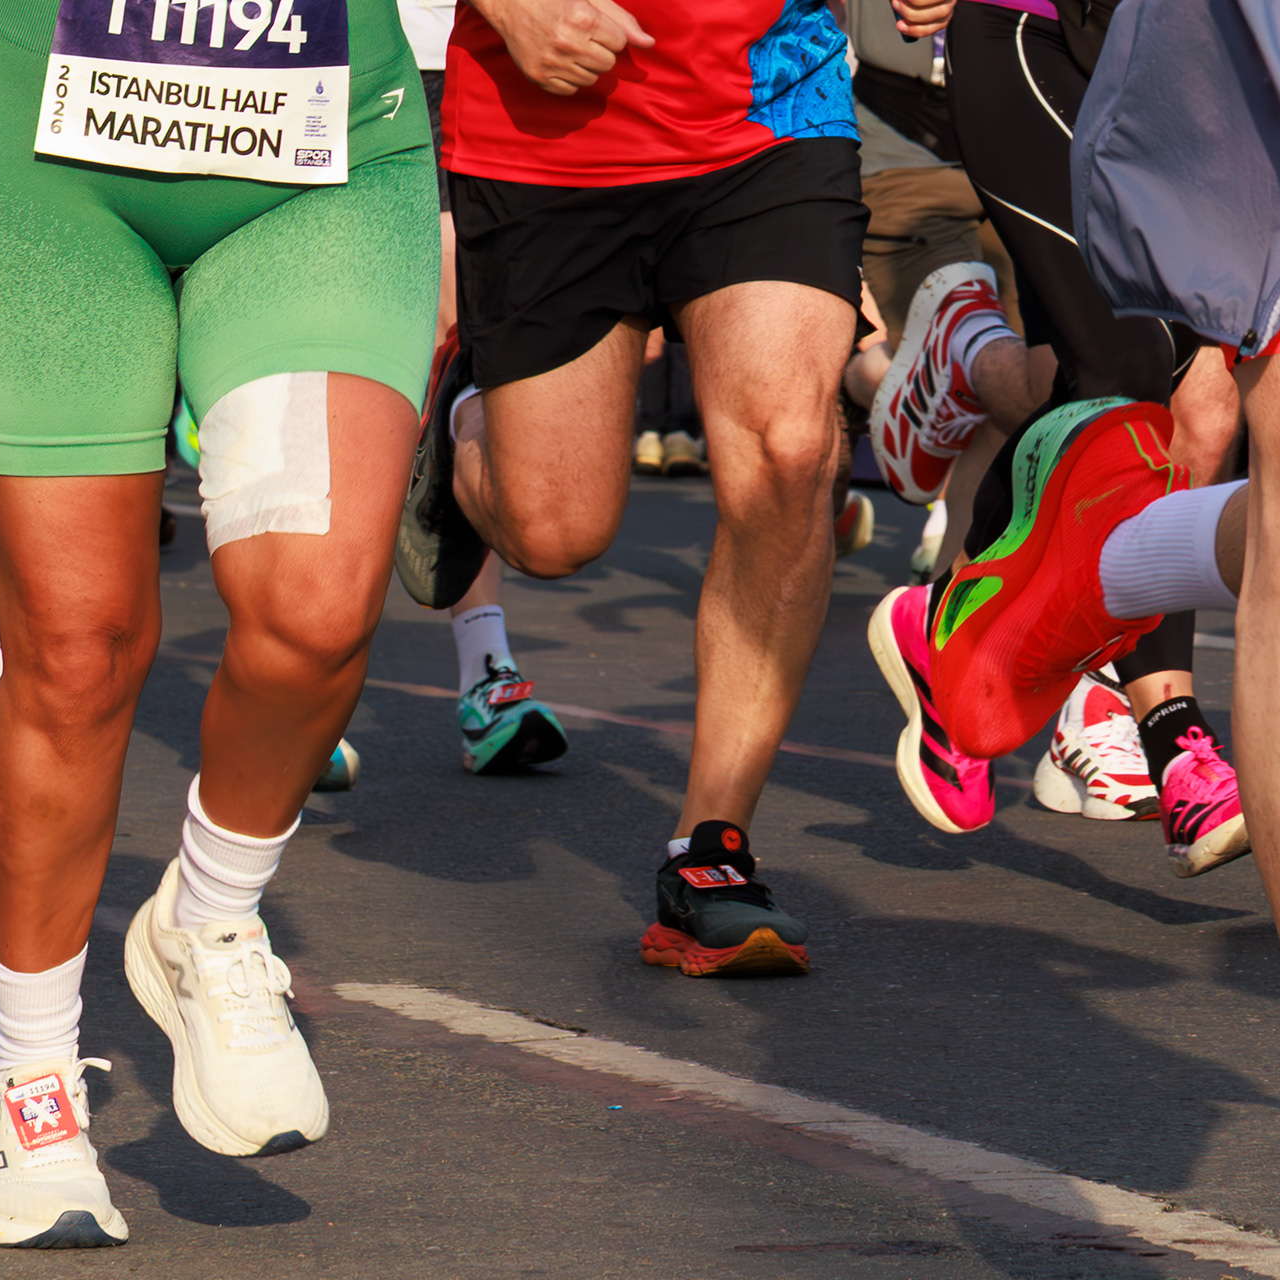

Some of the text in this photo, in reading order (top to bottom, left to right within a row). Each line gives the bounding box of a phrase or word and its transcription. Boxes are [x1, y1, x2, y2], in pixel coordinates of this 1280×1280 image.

[90, 71, 287, 115] ISTANBUL HALF
[84, 108, 283, 158] MARATHON
[297, 150, 330, 160] SPOR
